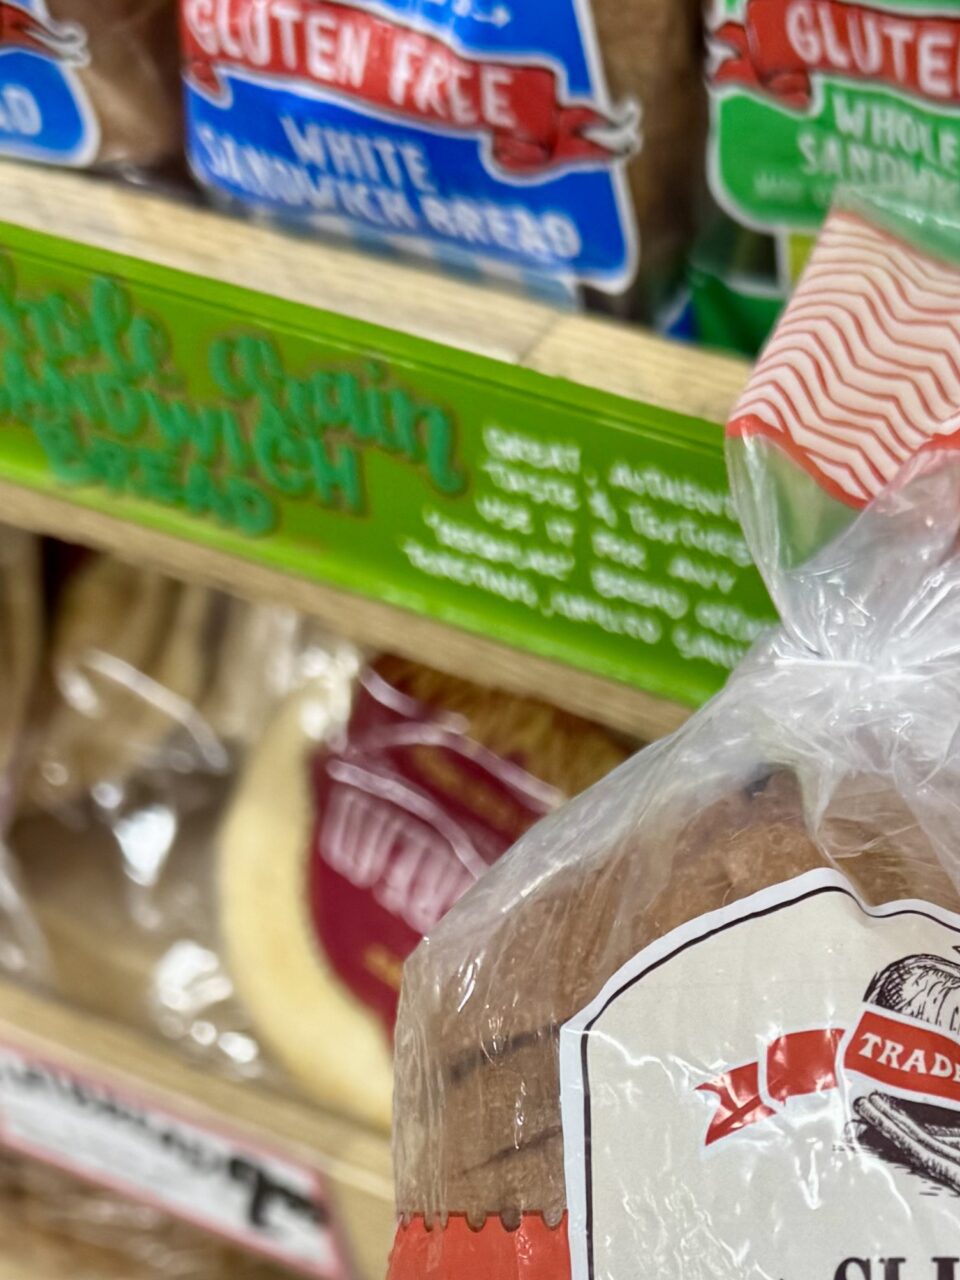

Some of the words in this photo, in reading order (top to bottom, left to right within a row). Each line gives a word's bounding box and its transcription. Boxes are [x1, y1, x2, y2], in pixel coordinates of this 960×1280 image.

[186, 0, 371, 88] GLUTEN
[389, 37, 518, 128] FREE
[280, 115, 432, 194] WHITE
[833, 94, 960, 176] WHOLE
[420, 195, 585, 260] BREAD
